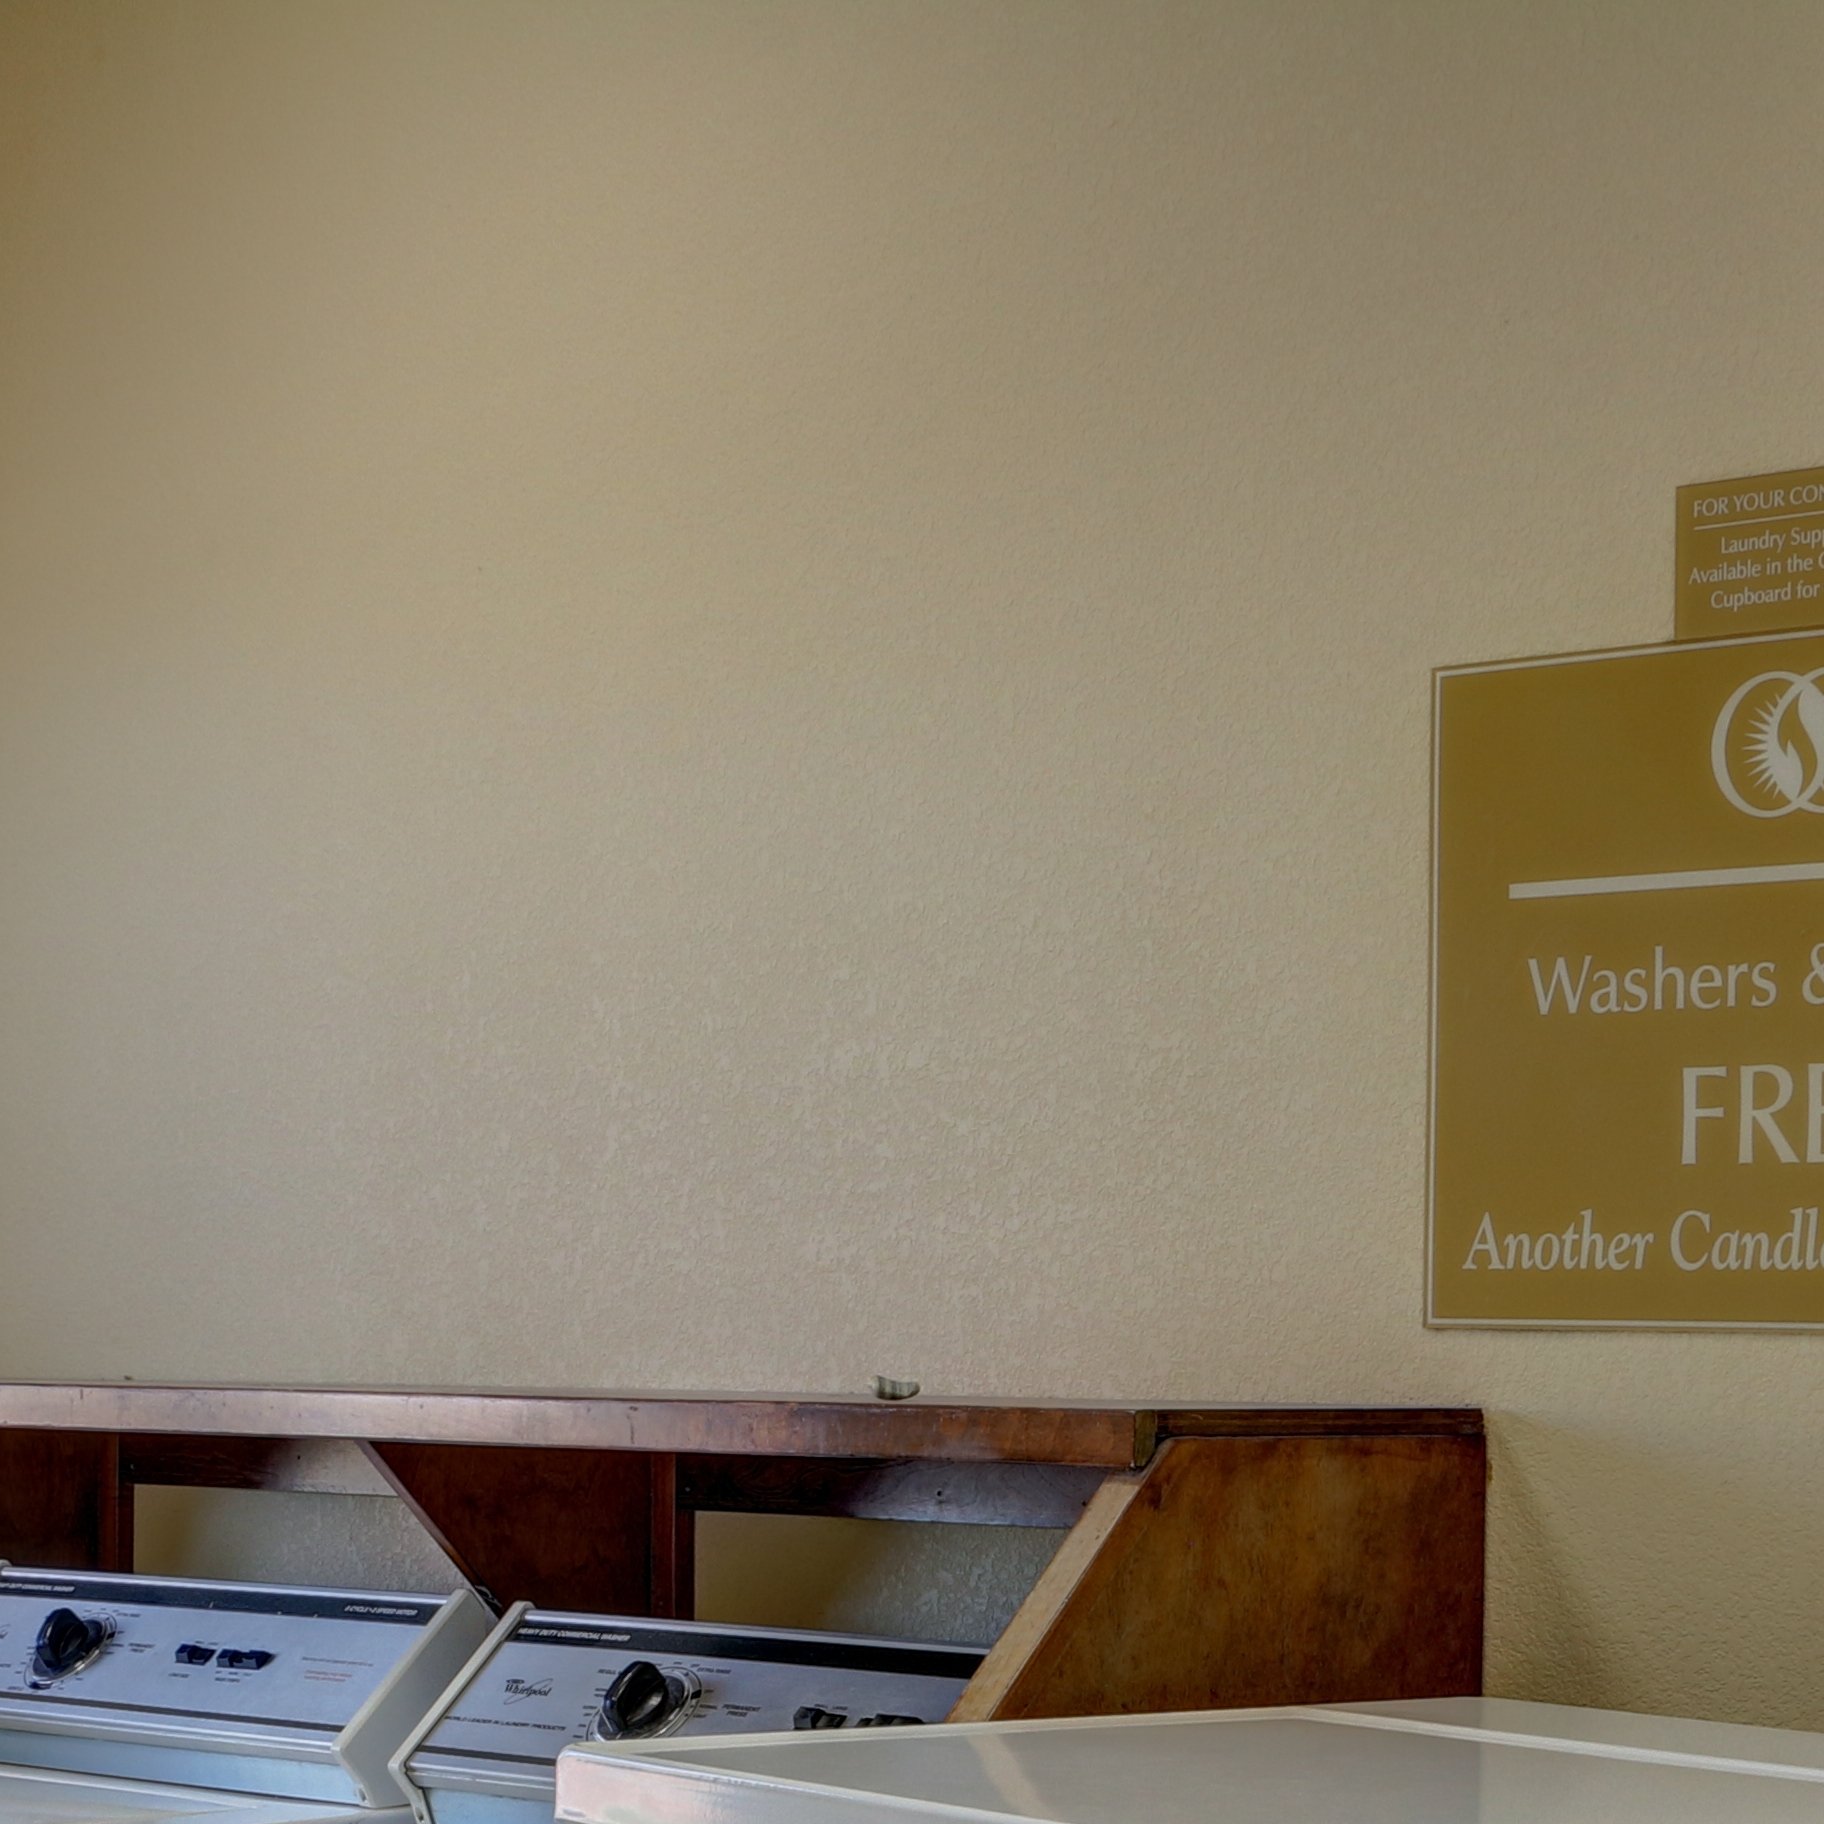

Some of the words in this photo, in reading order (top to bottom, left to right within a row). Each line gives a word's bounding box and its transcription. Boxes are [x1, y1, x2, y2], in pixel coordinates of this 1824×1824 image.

[1694, 498, 1729, 518] FOR
[1733, 489, 1784, 513] YOUR
[1721, 530, 1786, 554] Laundry
[1688, 561, 1761, 584] Available
[1766, 558, 1781, 575] in
[1787, 554, 1813, 573] the
[1711, 582, 1792, 612] Cupboard
[1797, 579, 1820, 599] for
[1527, 945, 1776, 1016] Washers
[1462, 1210, 1653, 1271] Another
[504, 1684, 552, 1696] Whirlpool
